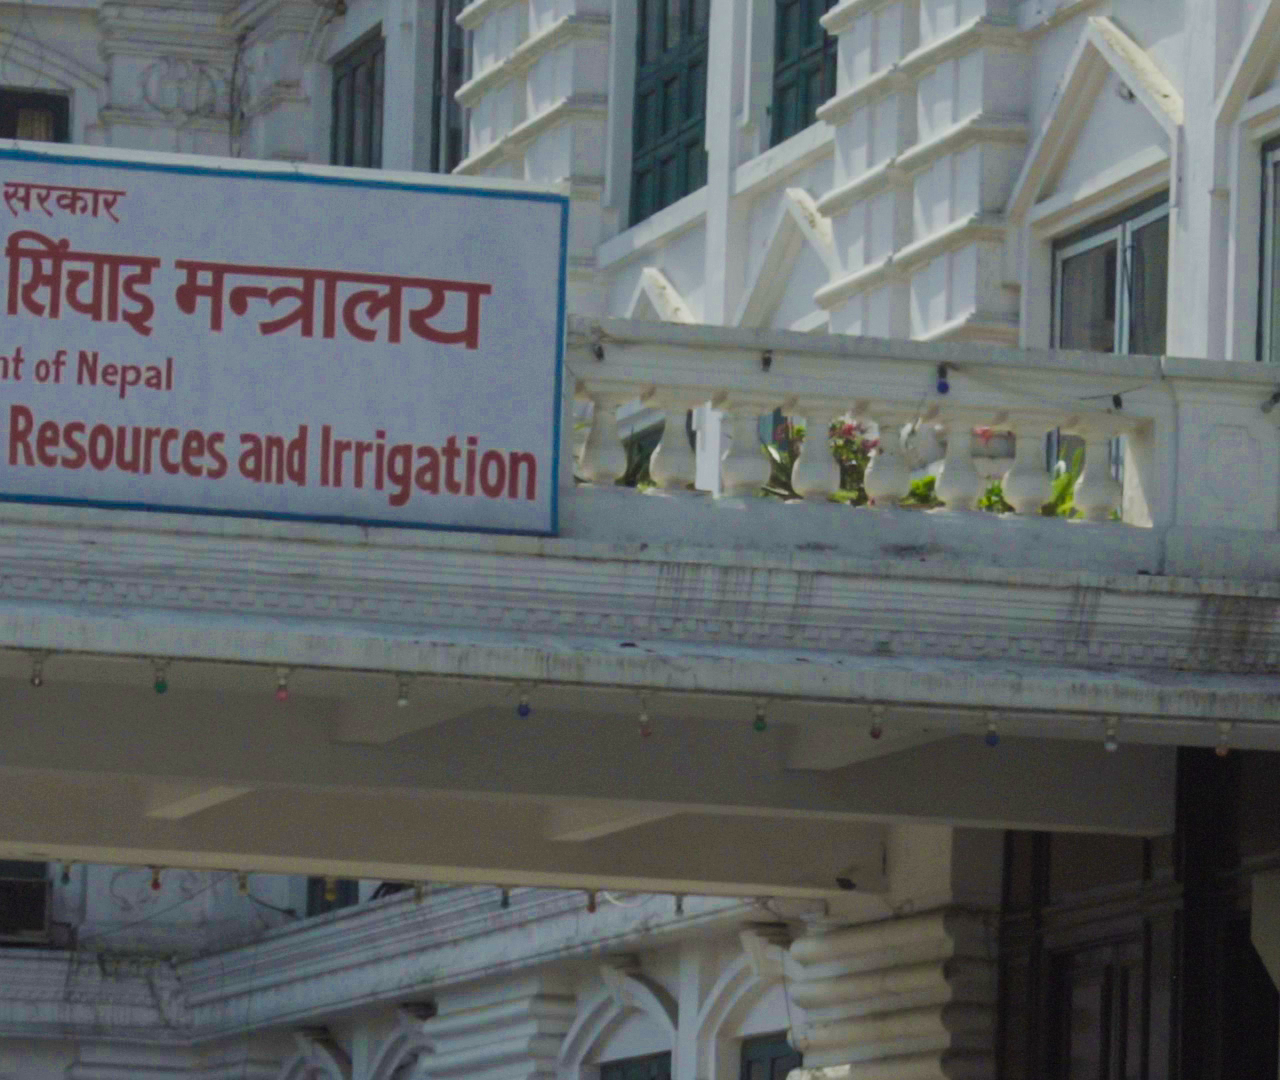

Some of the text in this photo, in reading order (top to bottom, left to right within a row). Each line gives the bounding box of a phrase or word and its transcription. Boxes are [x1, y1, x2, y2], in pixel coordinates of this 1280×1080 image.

[2, 181, 126, 223] सरकार
[5, 230, 161, 336] सिंचाइ
[174, 259, 491, 349] मन्त्रालय
[35, 350, 67, 383] of
[77, 350, 173, 399] Nepal
[9, 405, 227, 479] Resources
[238, 424, 307, 486] and
[320, 424, 537, 506] Irrigation
